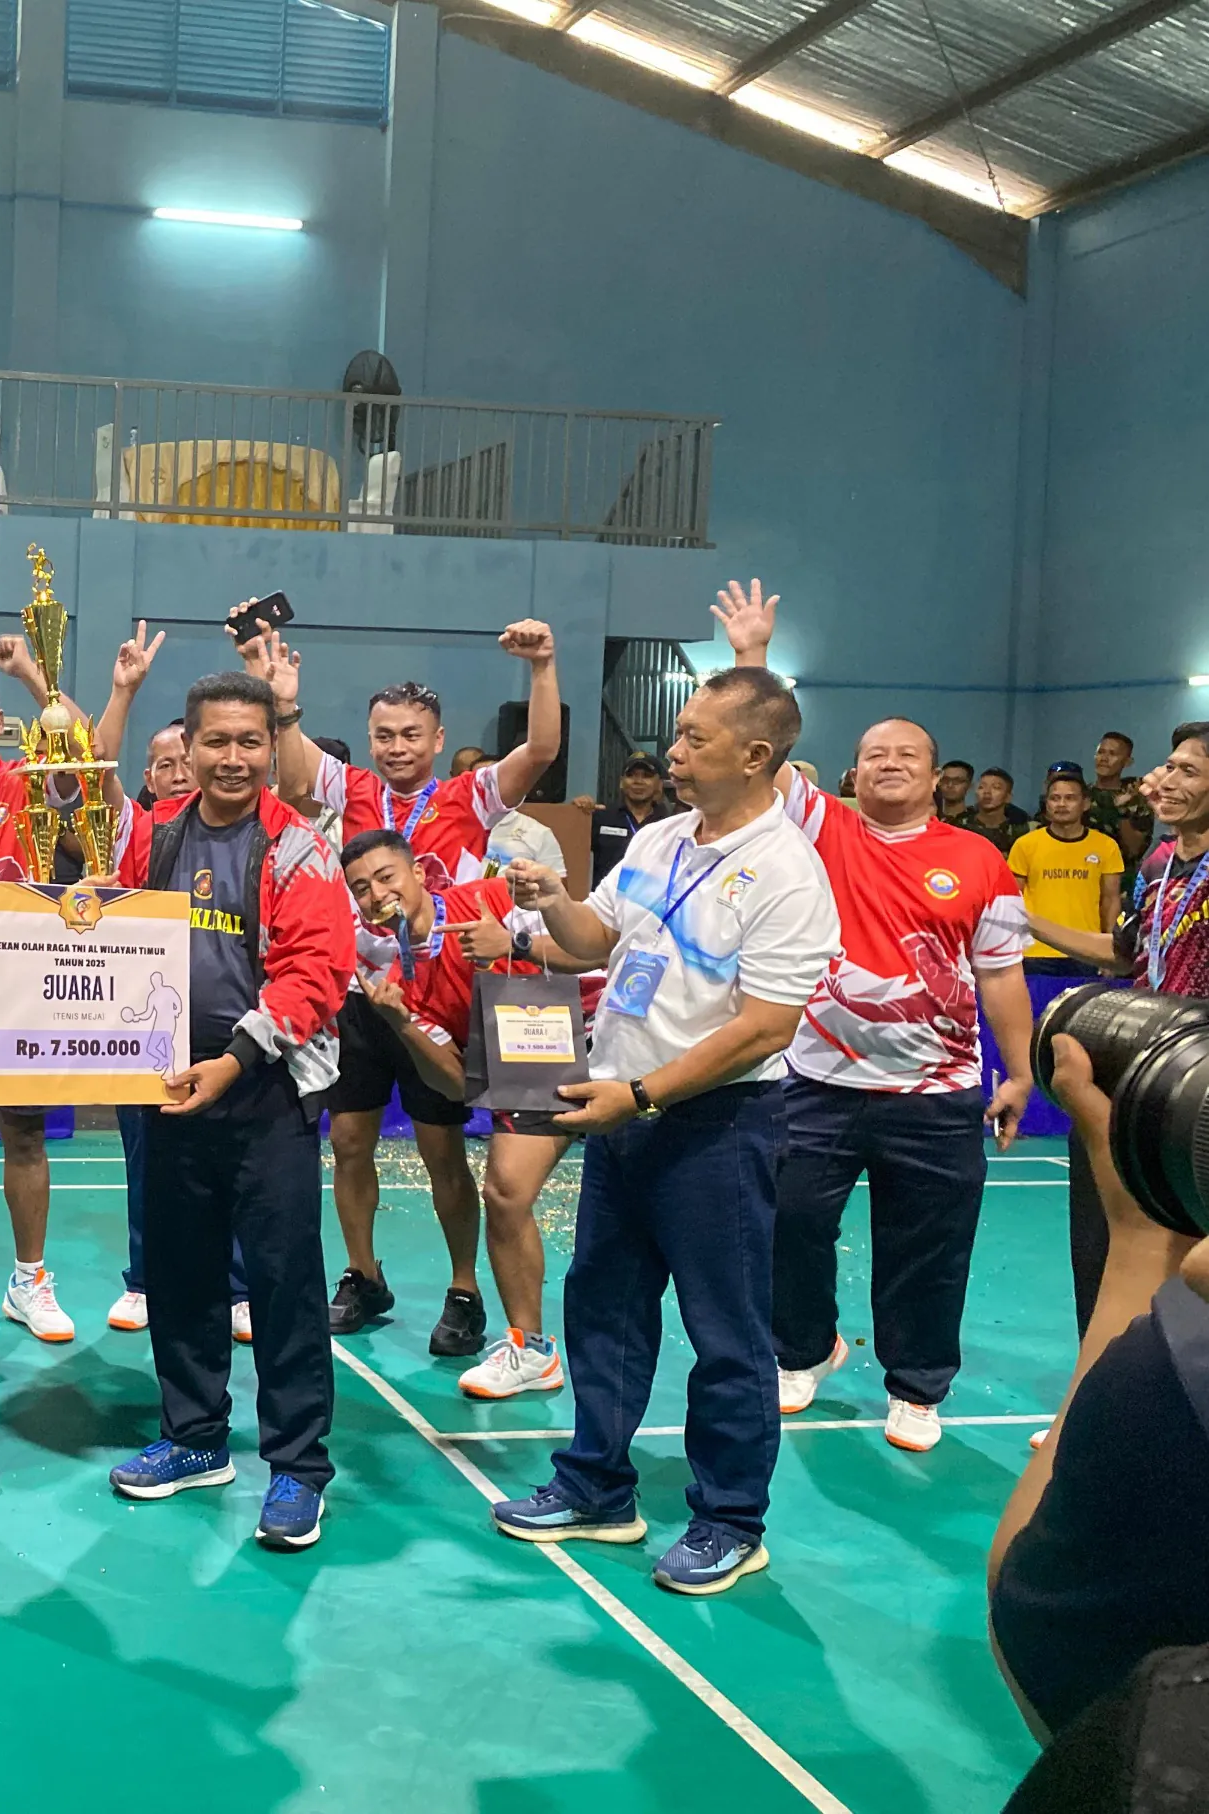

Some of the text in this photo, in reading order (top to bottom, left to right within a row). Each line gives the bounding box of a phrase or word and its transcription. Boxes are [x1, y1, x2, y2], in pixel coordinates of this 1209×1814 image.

[1043, 868, 1089, 880] PUSDIK POM
[22, 942, 45, 951] OLAH
[46, 943, 70, 953] RAGA
[72, 944, 86, 953] TNI
[88, 945, 98, 954] AL
[100, 945, 137, 955] WILAYAH
[139, 947, 166, 956] TIMUR
[55, 958, 106, 968] TAHUN 2025
[43, 974, 114, 1001] JUARA I
[16, 1039, 140, 1059] Rp. 7.500.000
